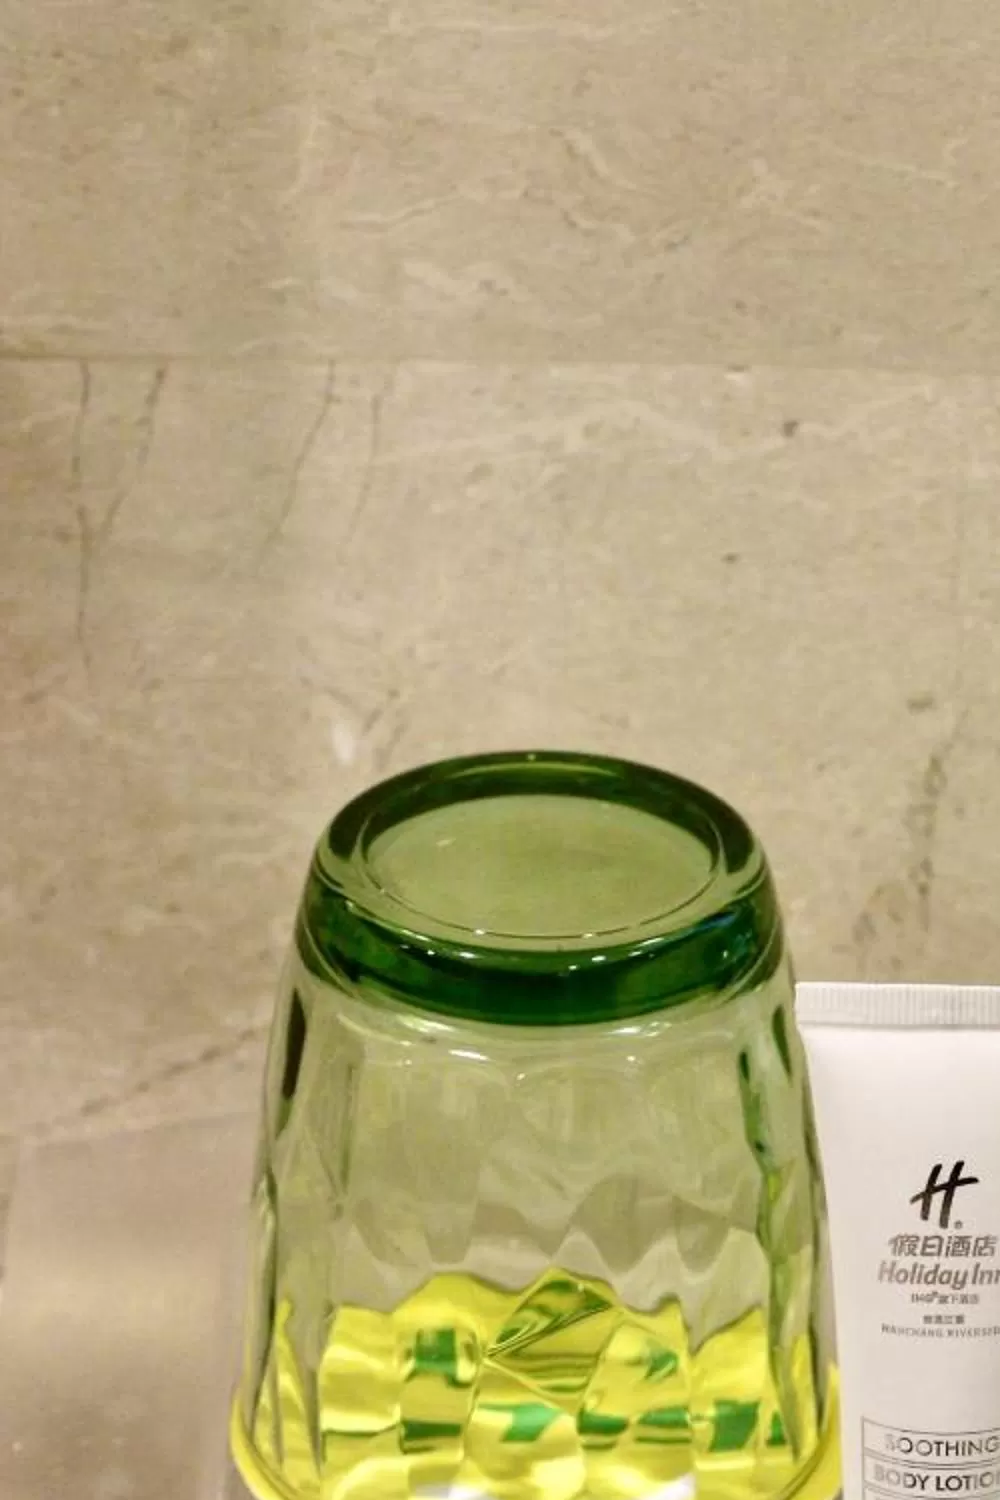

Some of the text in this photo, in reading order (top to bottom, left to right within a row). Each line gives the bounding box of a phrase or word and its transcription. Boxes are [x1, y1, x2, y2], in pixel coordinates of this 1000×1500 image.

[888, 1234, 998, 1258] 假日酒店
[877, 1261, 969, 1290] Holiday
[884, 1433, 1000, 1457] SOOTHING
[873, 1463, 931, 1490] BODY
